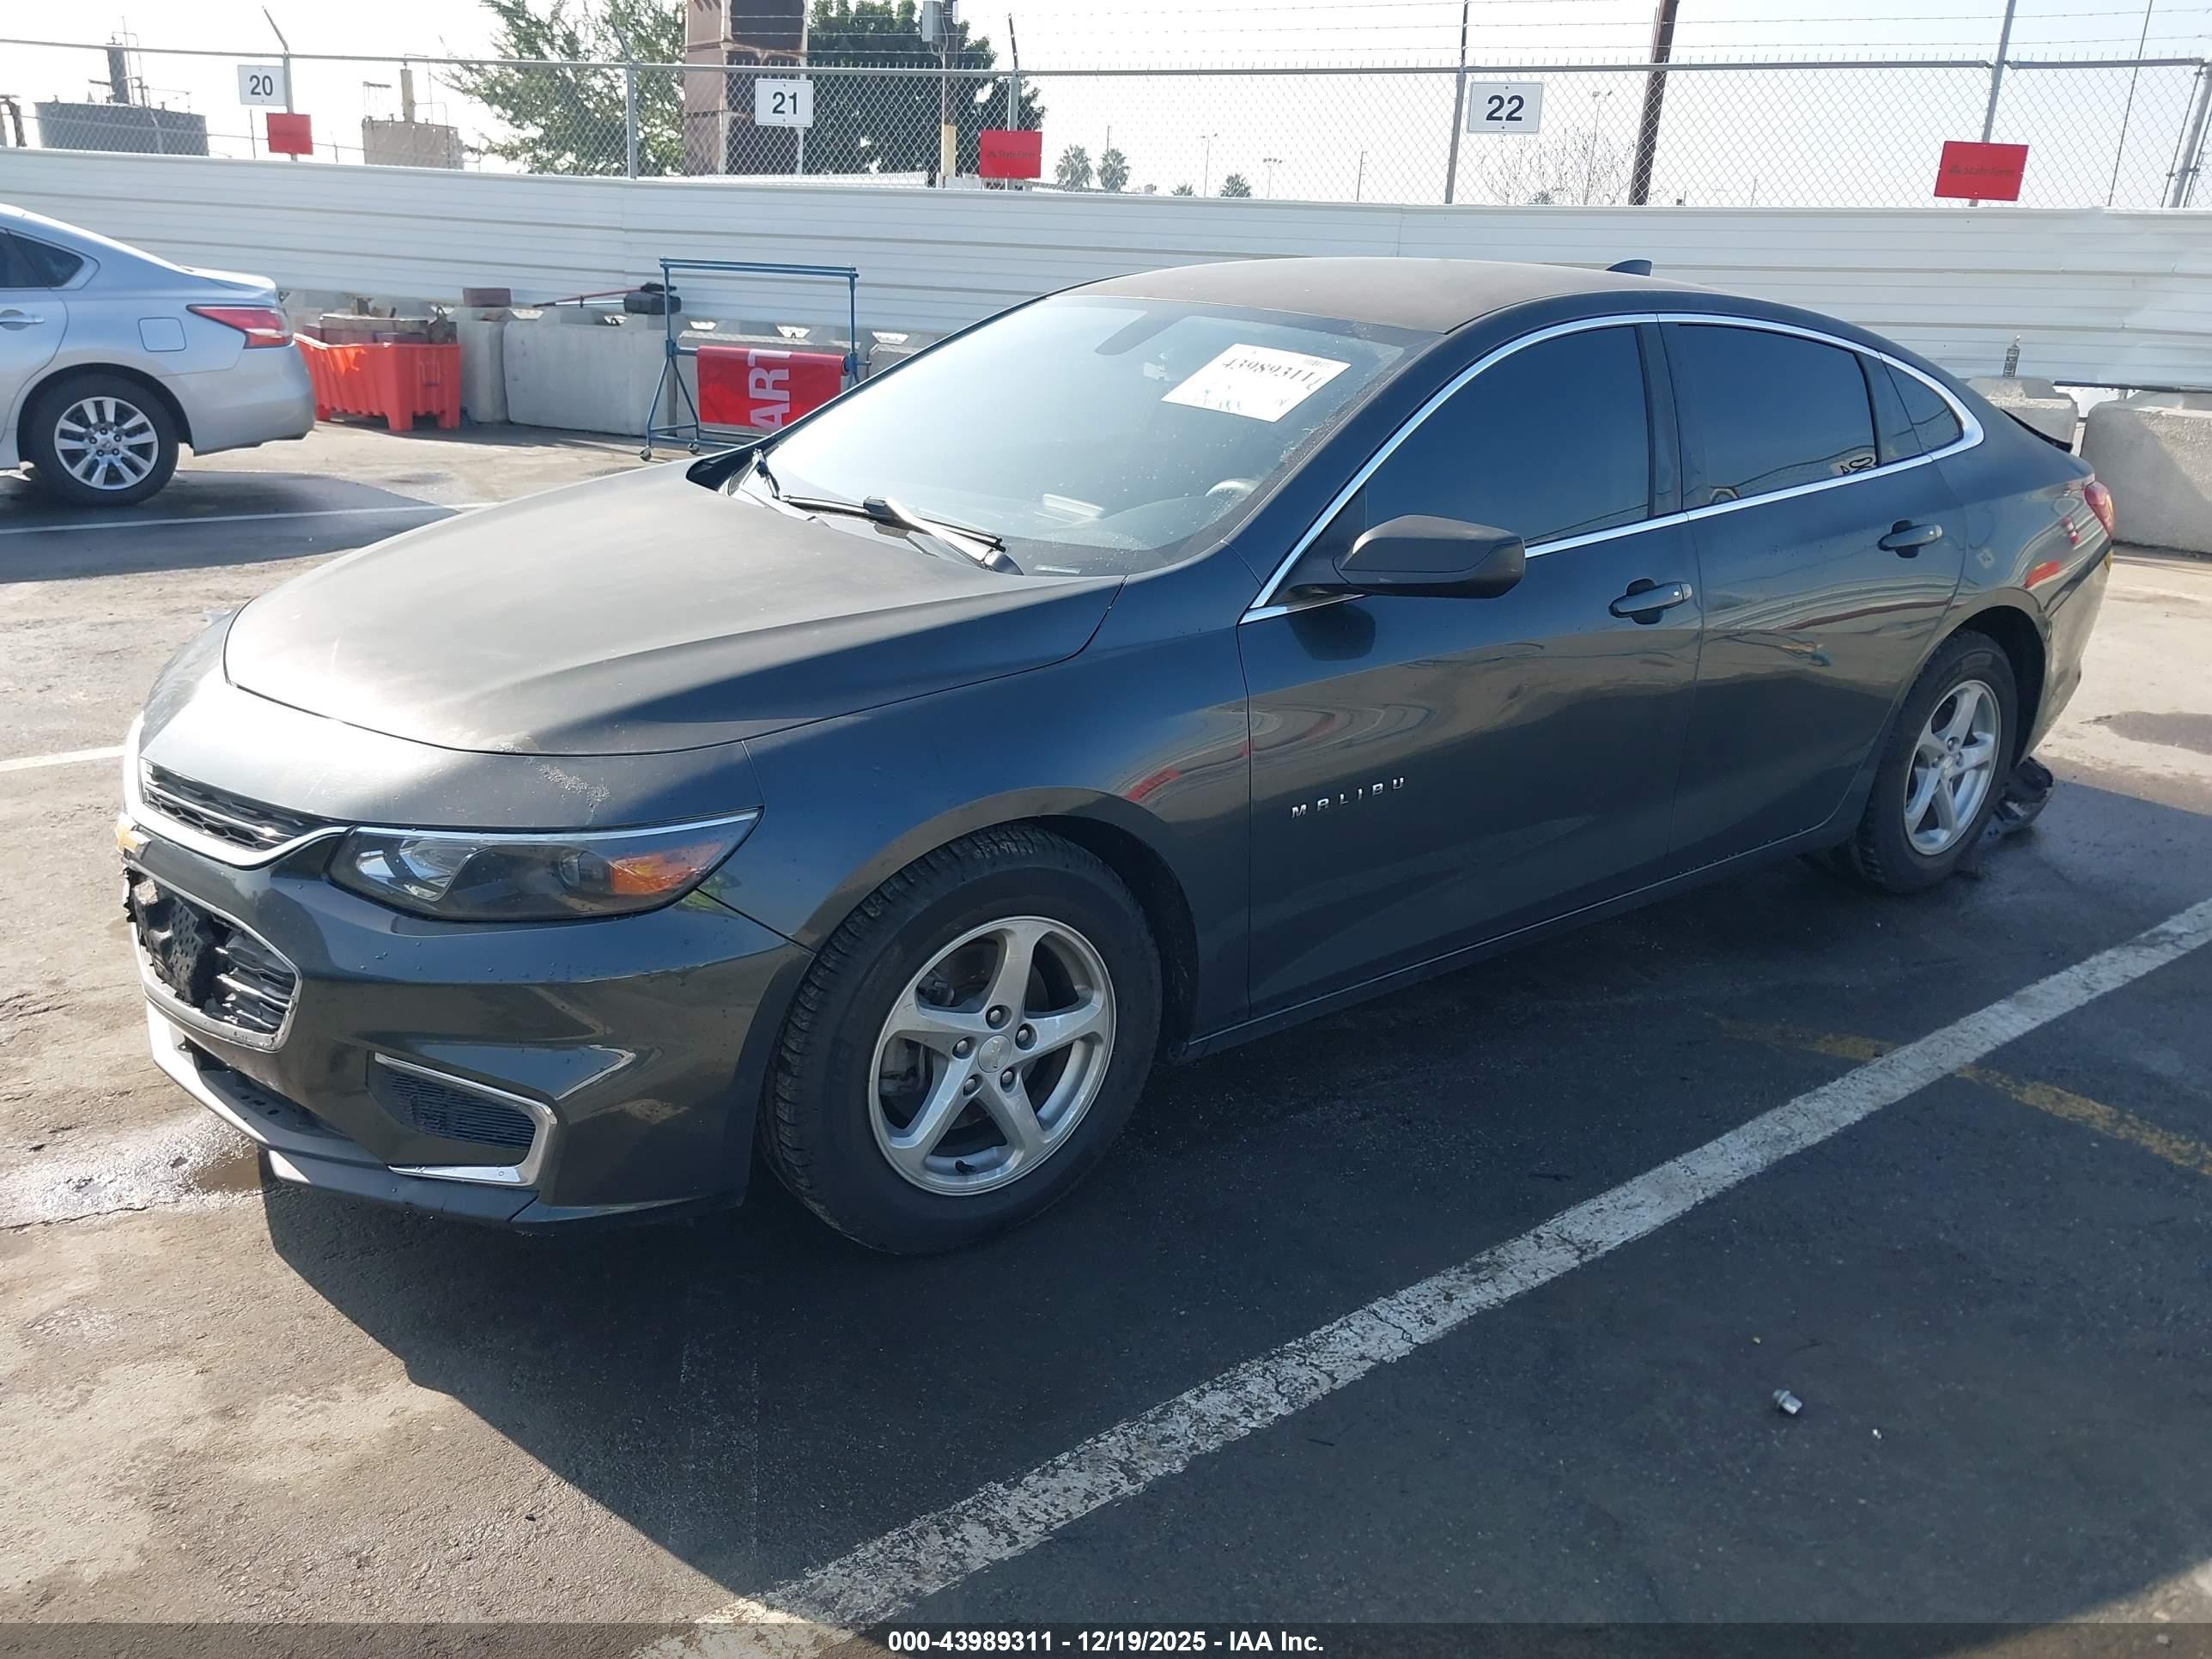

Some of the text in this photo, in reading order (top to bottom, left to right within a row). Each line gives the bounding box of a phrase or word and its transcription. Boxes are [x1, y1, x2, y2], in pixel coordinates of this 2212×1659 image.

[249, 75, 273, 96] 20
[772, 91, 797, 115] 21
[1486, 94, 1524, 121] 22
[1291, 777, 1405, 818] MALIBU
